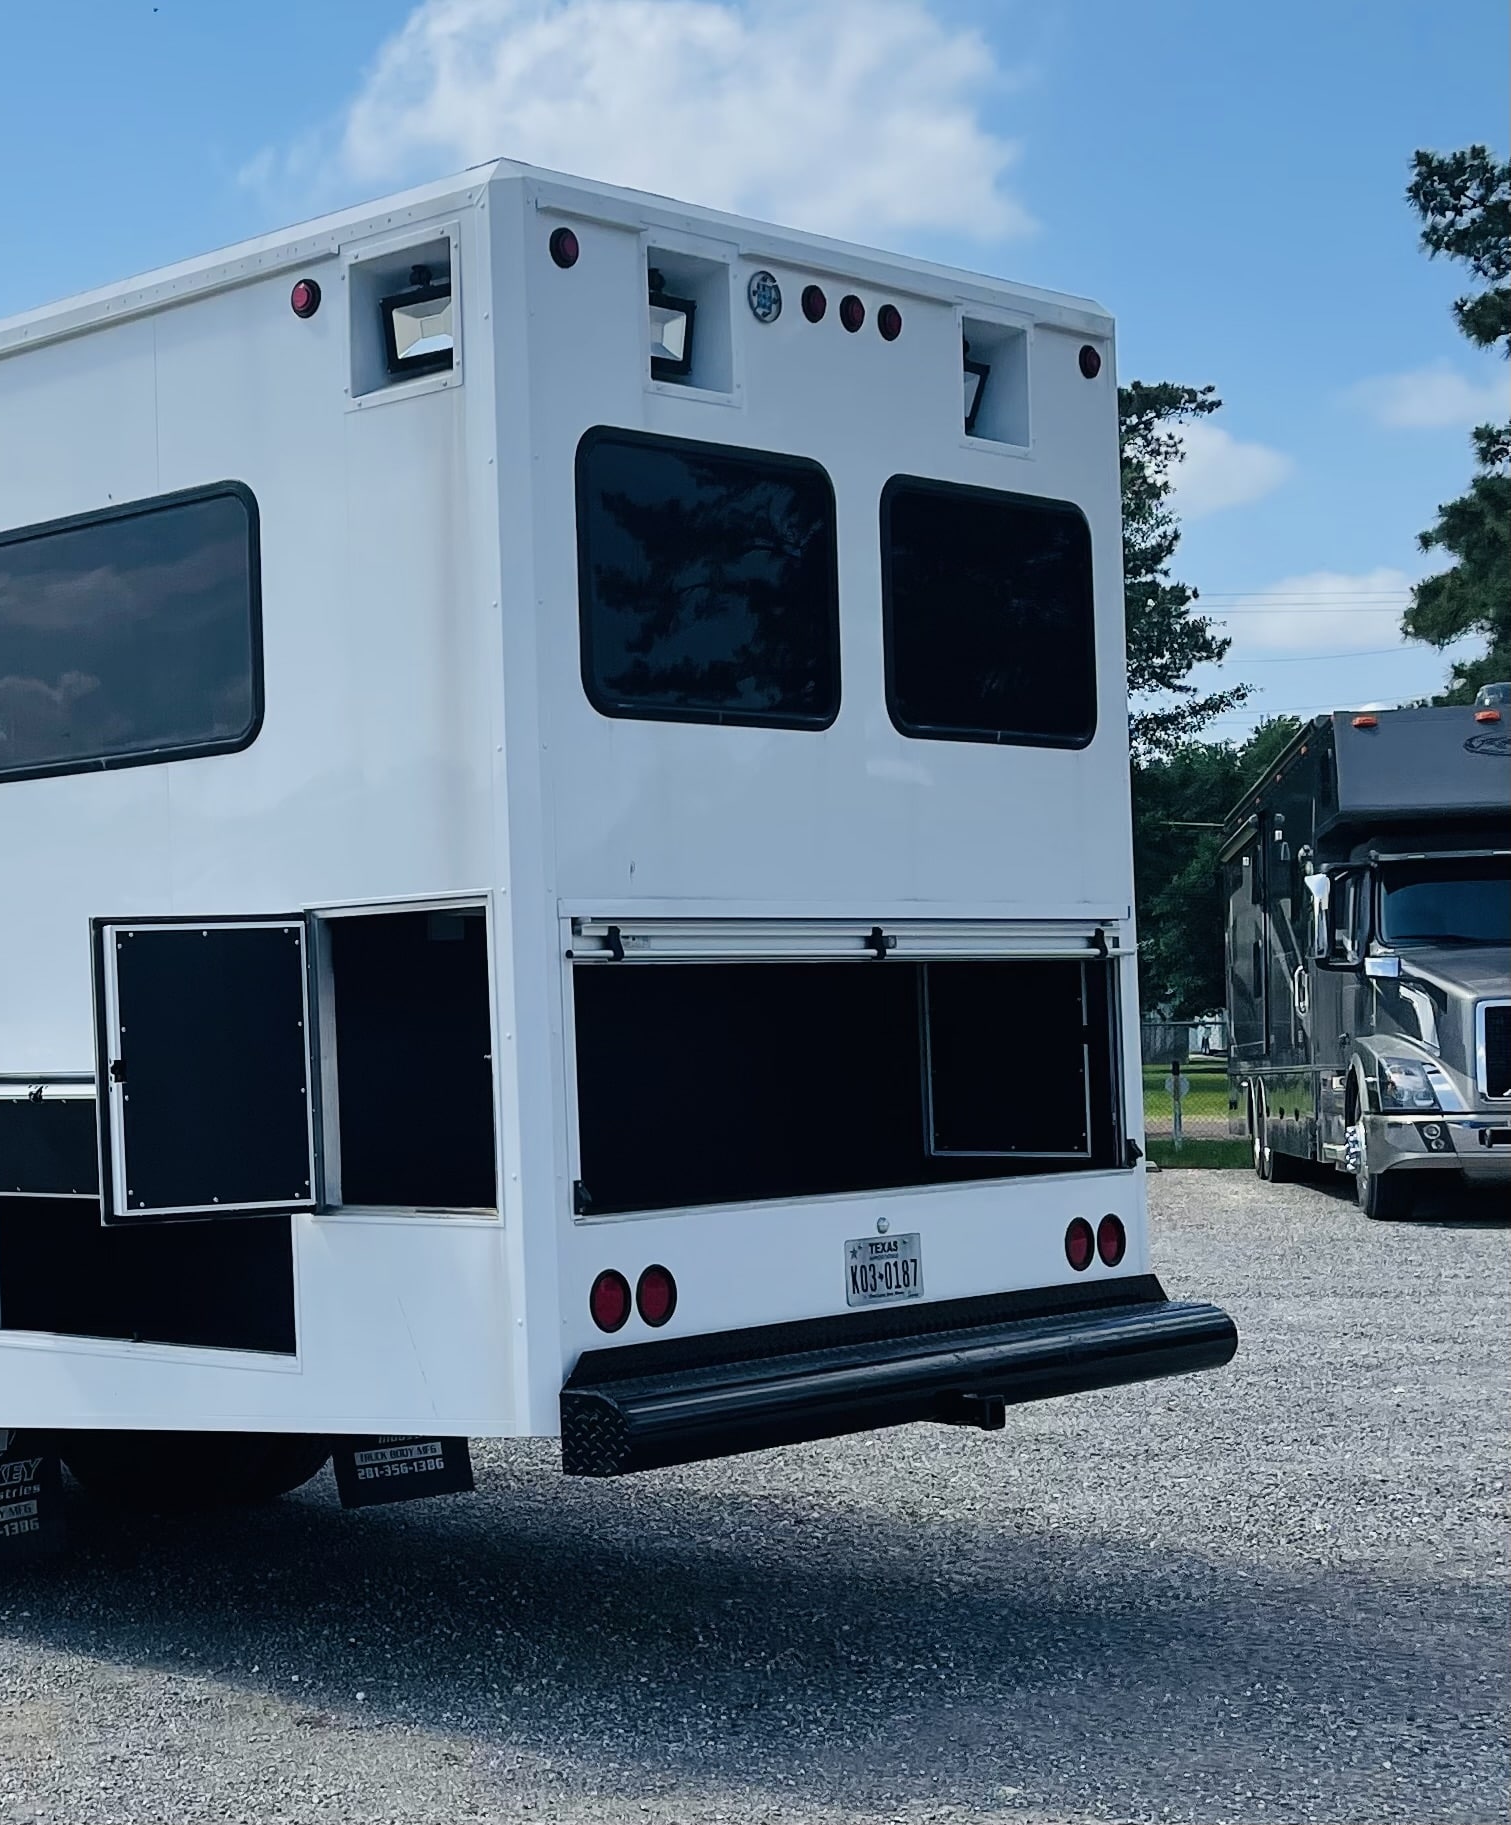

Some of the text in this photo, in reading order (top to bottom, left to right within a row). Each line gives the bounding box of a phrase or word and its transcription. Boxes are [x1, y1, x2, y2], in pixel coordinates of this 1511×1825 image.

[869, 1240, 898, 1254] TEXAS
[884, 1258, 917, 1290] 0187
[390, 1448, 414, 1458] BODY
[357, 1458, 445, 1480] 281-356-1386
[7, 1503, 32, 1517] MFG
